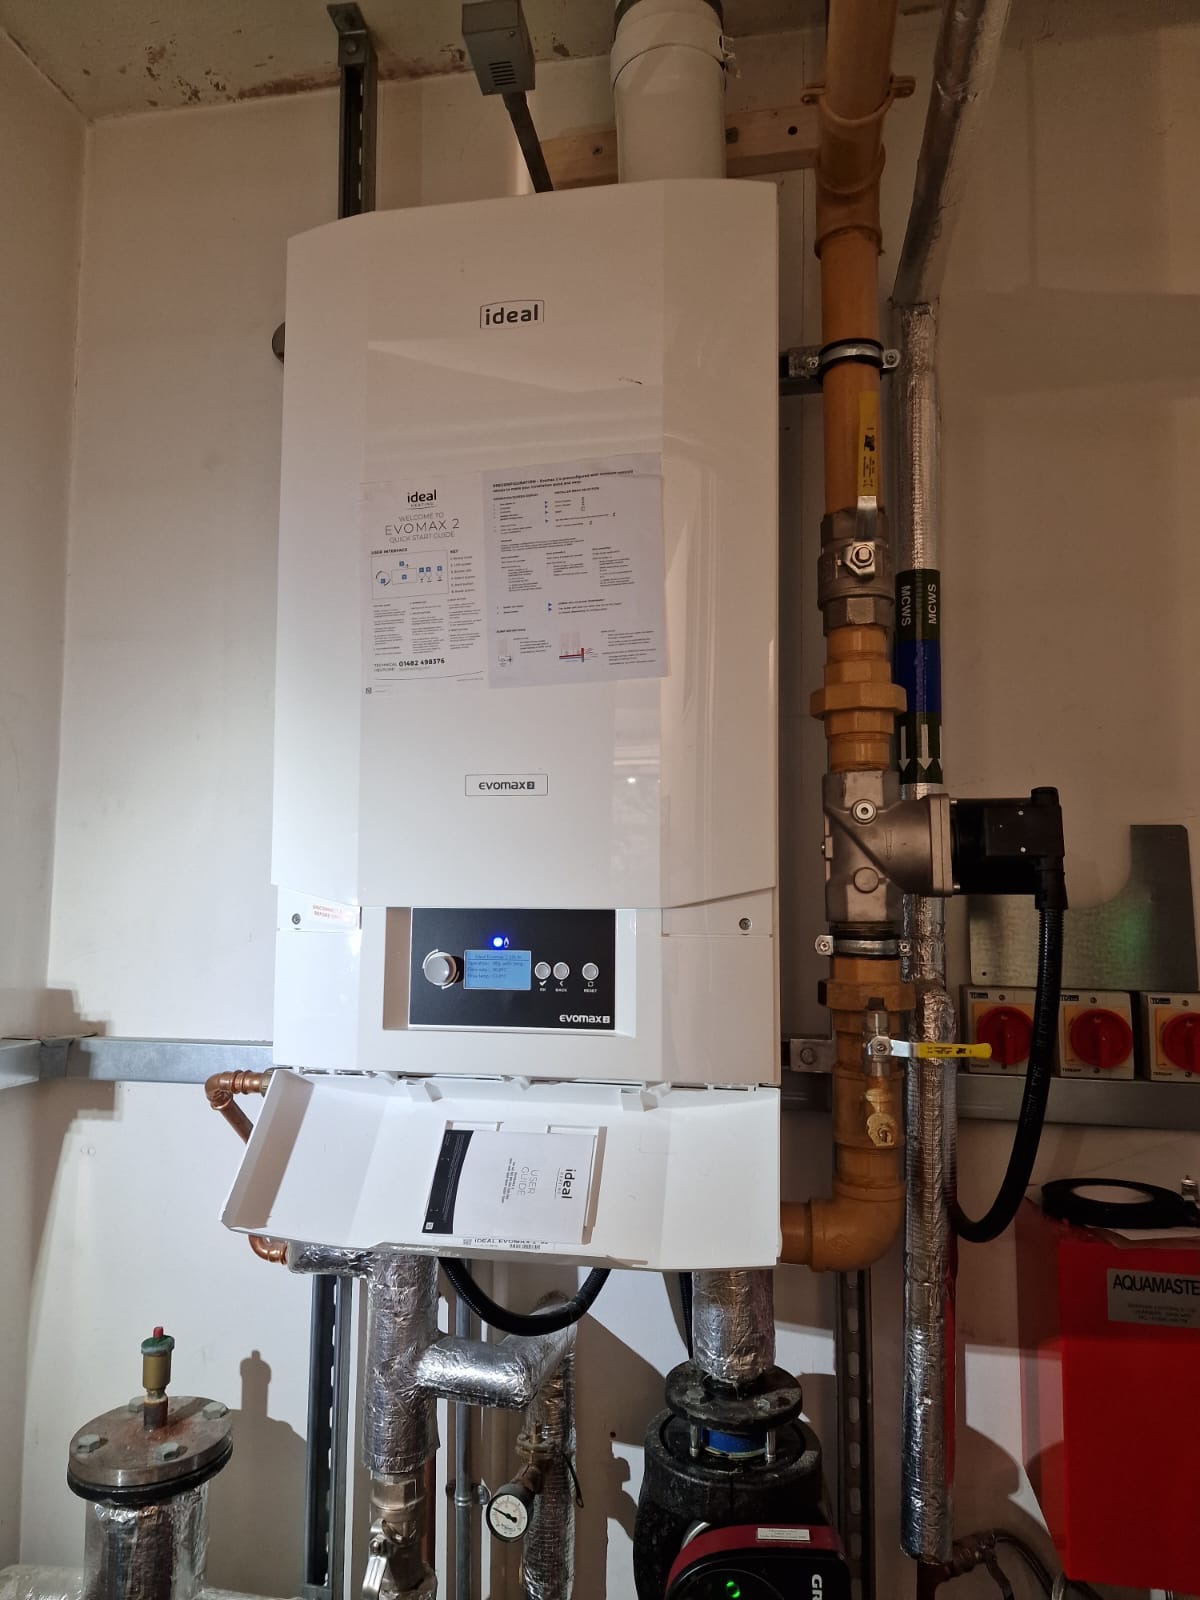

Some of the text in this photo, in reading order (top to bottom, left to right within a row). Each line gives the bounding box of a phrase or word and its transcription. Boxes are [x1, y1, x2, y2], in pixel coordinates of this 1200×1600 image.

[485, 303, 539, 326] ideal
[407, 489, 437, 503] ideal
[384, 518, 460, 536] EVOMAX 2
[398, 511, 444, 522] WELCOME TO
[389, 530, 455, 544] QUICK START GUIDE
[901, 585, 911, 627] MCWS
[927, 583, 937, 625] MCWS
[398, 660, 420, 668] 01482
[420, 657, 445, 666] 498376
[517, 1166, 530, 1197] GUIDE
[527, 1168, 541, 1194] USER
[561, 1168, 577, 1199] ideal
